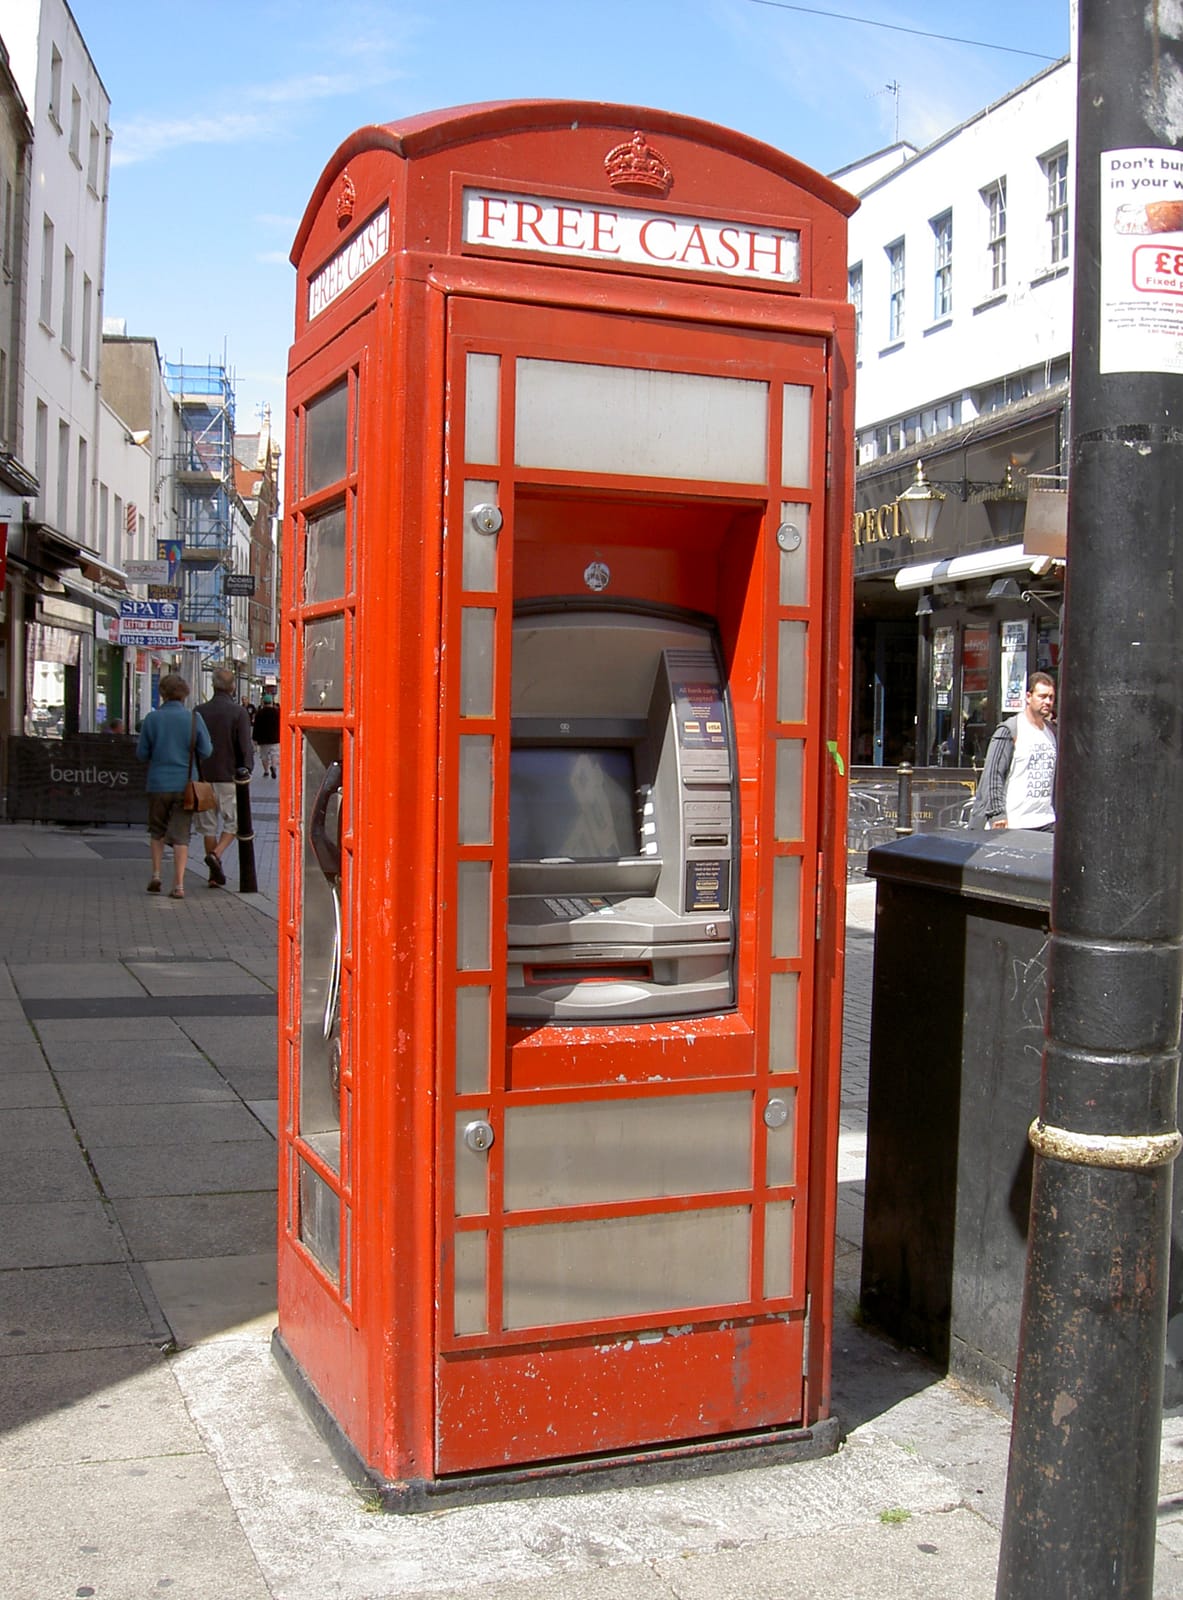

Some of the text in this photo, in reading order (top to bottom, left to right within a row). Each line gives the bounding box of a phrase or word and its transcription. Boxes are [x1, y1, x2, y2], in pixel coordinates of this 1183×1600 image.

[1110, 157, 1154, 171] Don't
[1110, 177, 1125, 189] in
[1131, 178, 1169, 191] your
[477, 196, 786, 276] FREE CASH
[312, 209, 389, 314] FREE CASH
[1145, 276, 1177, 287] Fixed
[853, 502, 909, 547] PECT
[122, 601, 155, 615] SPA
[50, 763, 129, 788] bentleys
